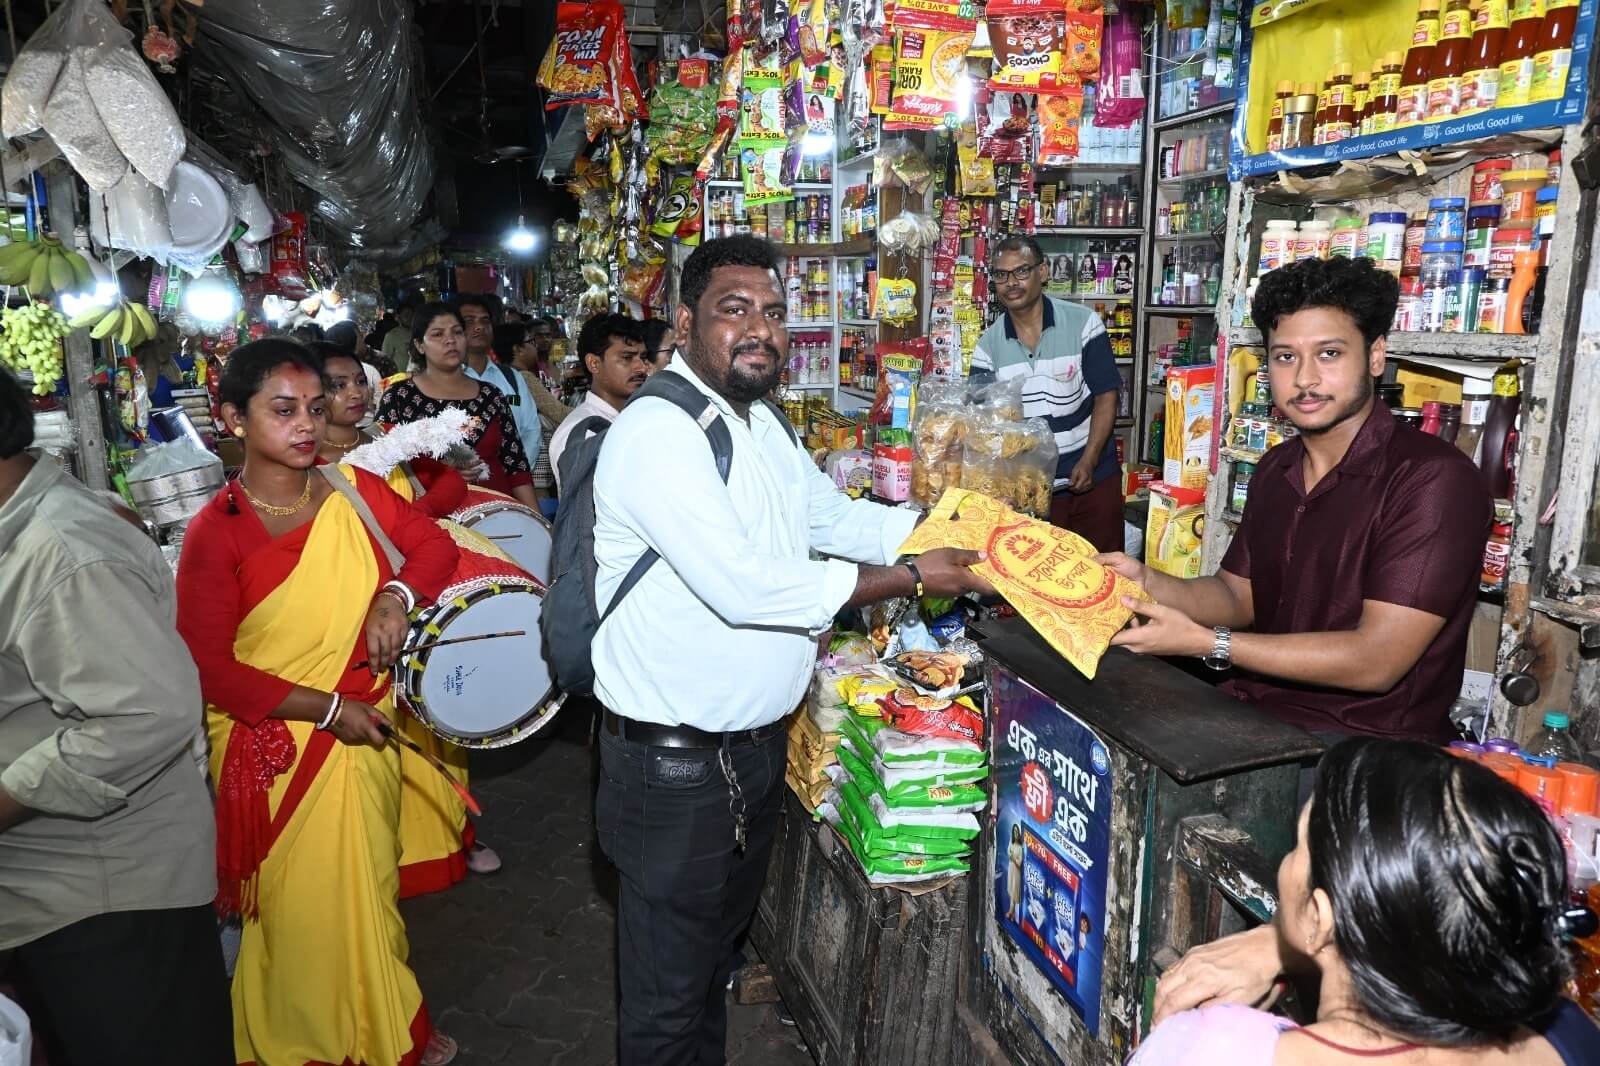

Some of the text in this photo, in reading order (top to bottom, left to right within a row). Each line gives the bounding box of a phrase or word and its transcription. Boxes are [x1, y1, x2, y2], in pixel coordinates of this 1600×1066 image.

[928, 2, 950, 12] SAVE
[557, 25, 607, 44] CORN
[559, 41, 602, 53] FLAKES
[573, 49, 600, 60] MIX
[1009, 54, 1050, 68] CHOCOS
[1444, 113, 1524, 136] Good food, Good life
[1342, 144, 1359, 154] Good
[1377, 139, 1396, 149] Good
[1396, 136, 1408, 146] life
[1007, 719, 1037, 761] এক
[1052, 748, 1099, 812] সাথে
[1024, 768, 1089, 843] ফ্রী এক
[1053, 859, 1073, 885] FREE
